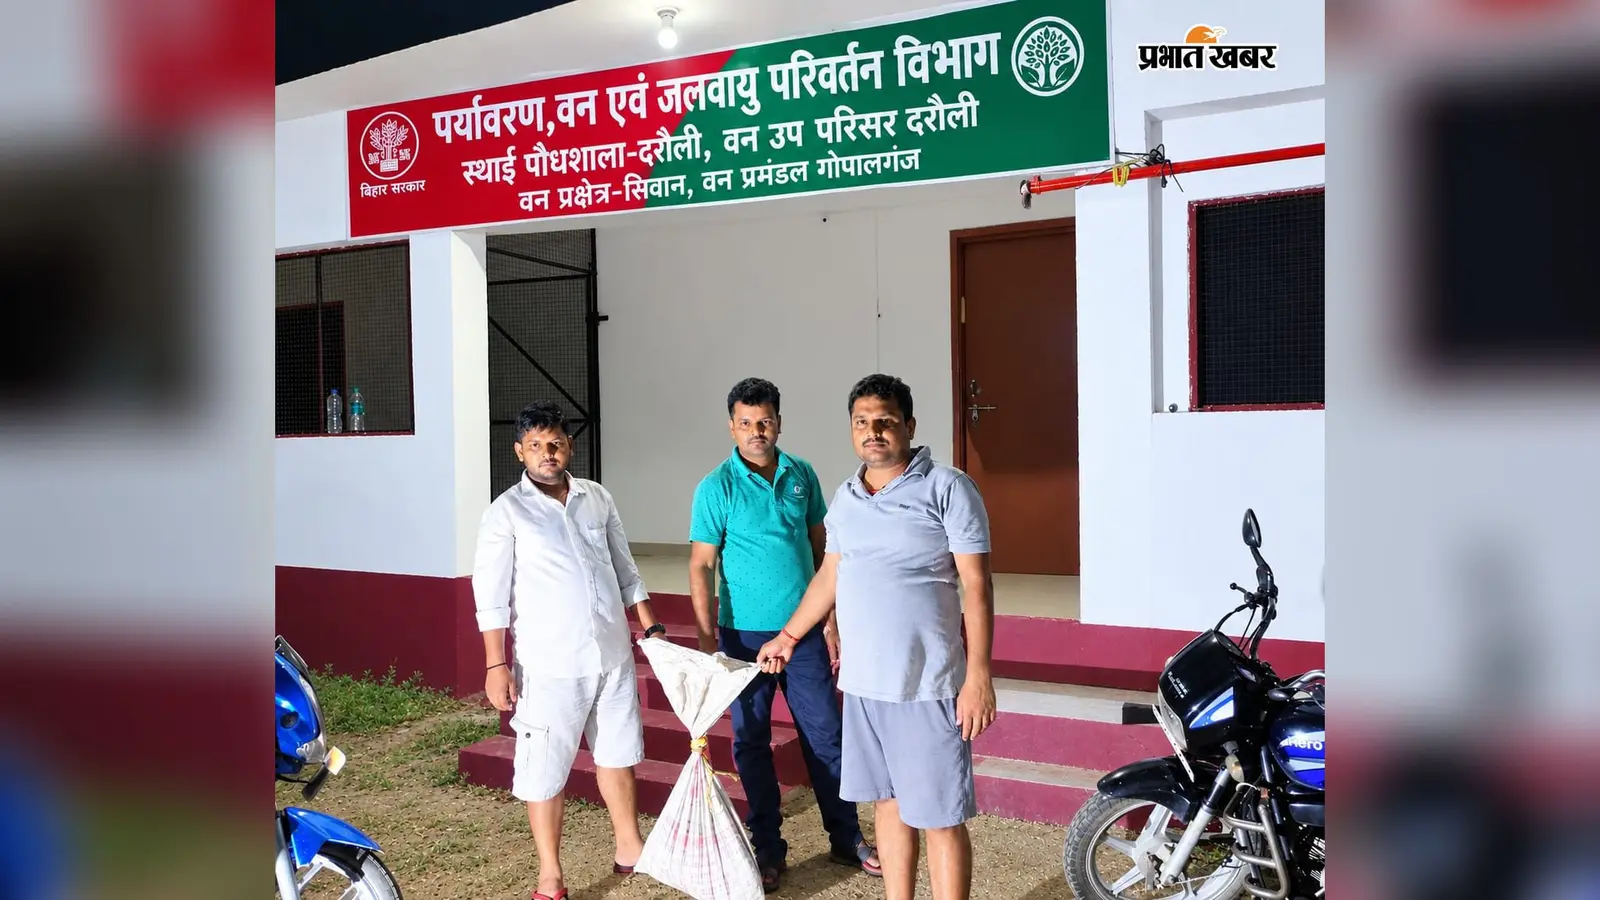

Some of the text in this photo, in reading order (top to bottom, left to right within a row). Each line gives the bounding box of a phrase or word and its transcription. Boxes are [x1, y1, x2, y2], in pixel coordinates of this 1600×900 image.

[605, 72, 649, 128] एवं
[656, 66, 761, 116] जलवायु
[767, 41, 884, 100] परिवर्तन
[892, 32, 1002, 87] विभाग
[461, 145, 516, 186] स्थाई
[722, 125, 760, 154] वन
[768, 120, 804, 149] उप
[814, 105, 898, 144] परिसर
[904, 90, 980, 137] दरौली
[360, 179, 426, 198] बिहार सरकार
[518, 189, 550, 212] वन
[702, 169, 734, 192] वन
[741, 160, 809, 189] प्रमंडल
[816, 148, 922, 179] गोपालगंज
